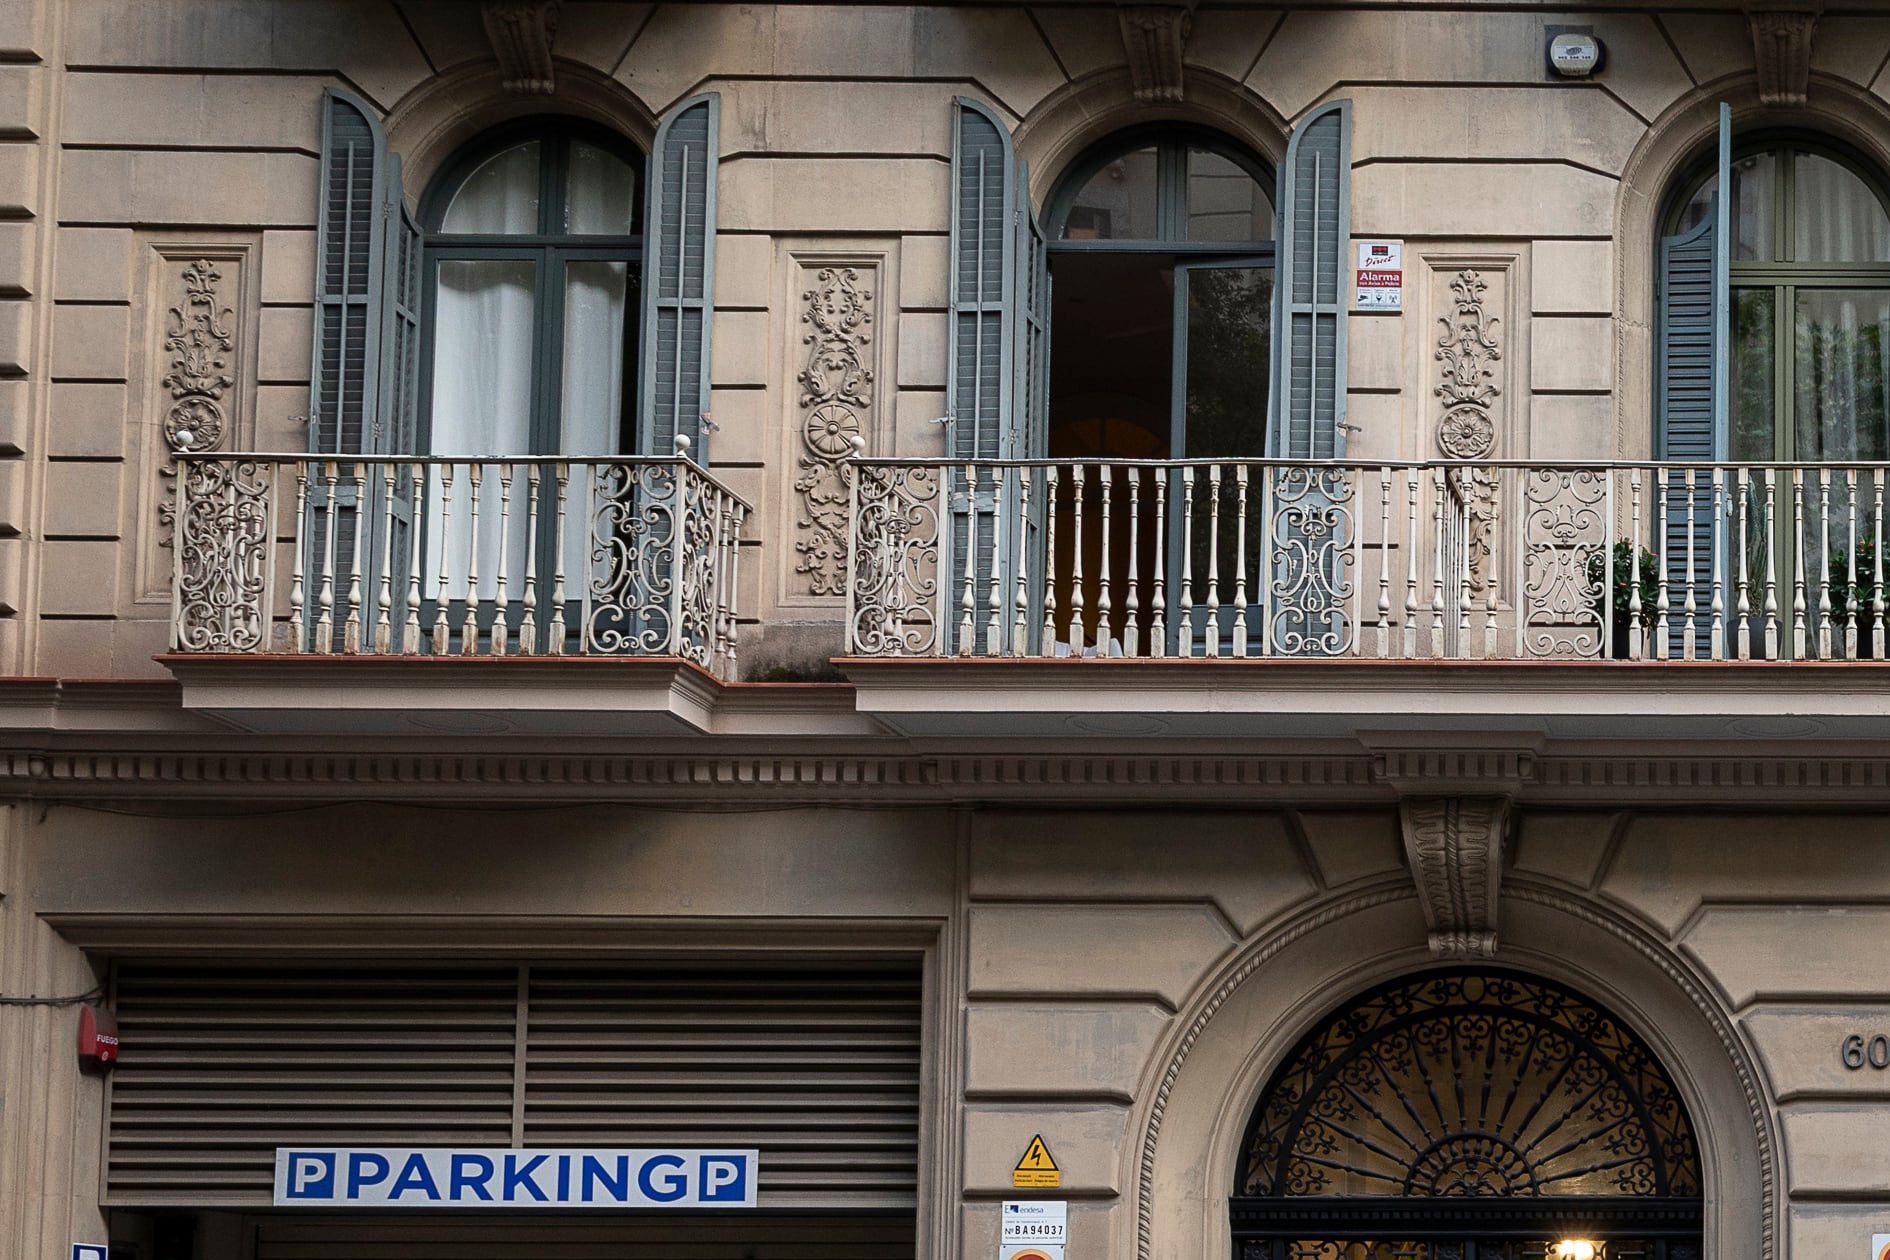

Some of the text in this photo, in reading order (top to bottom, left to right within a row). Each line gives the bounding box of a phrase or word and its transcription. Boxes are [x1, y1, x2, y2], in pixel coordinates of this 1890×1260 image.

[1360, 271, 1400, 281] Alarma
[96, 1034, 119, 1046] FUEGO
[346, 1152, 688, 1203] PARKING
[1020, 1206, 1044, 1214] endesa
